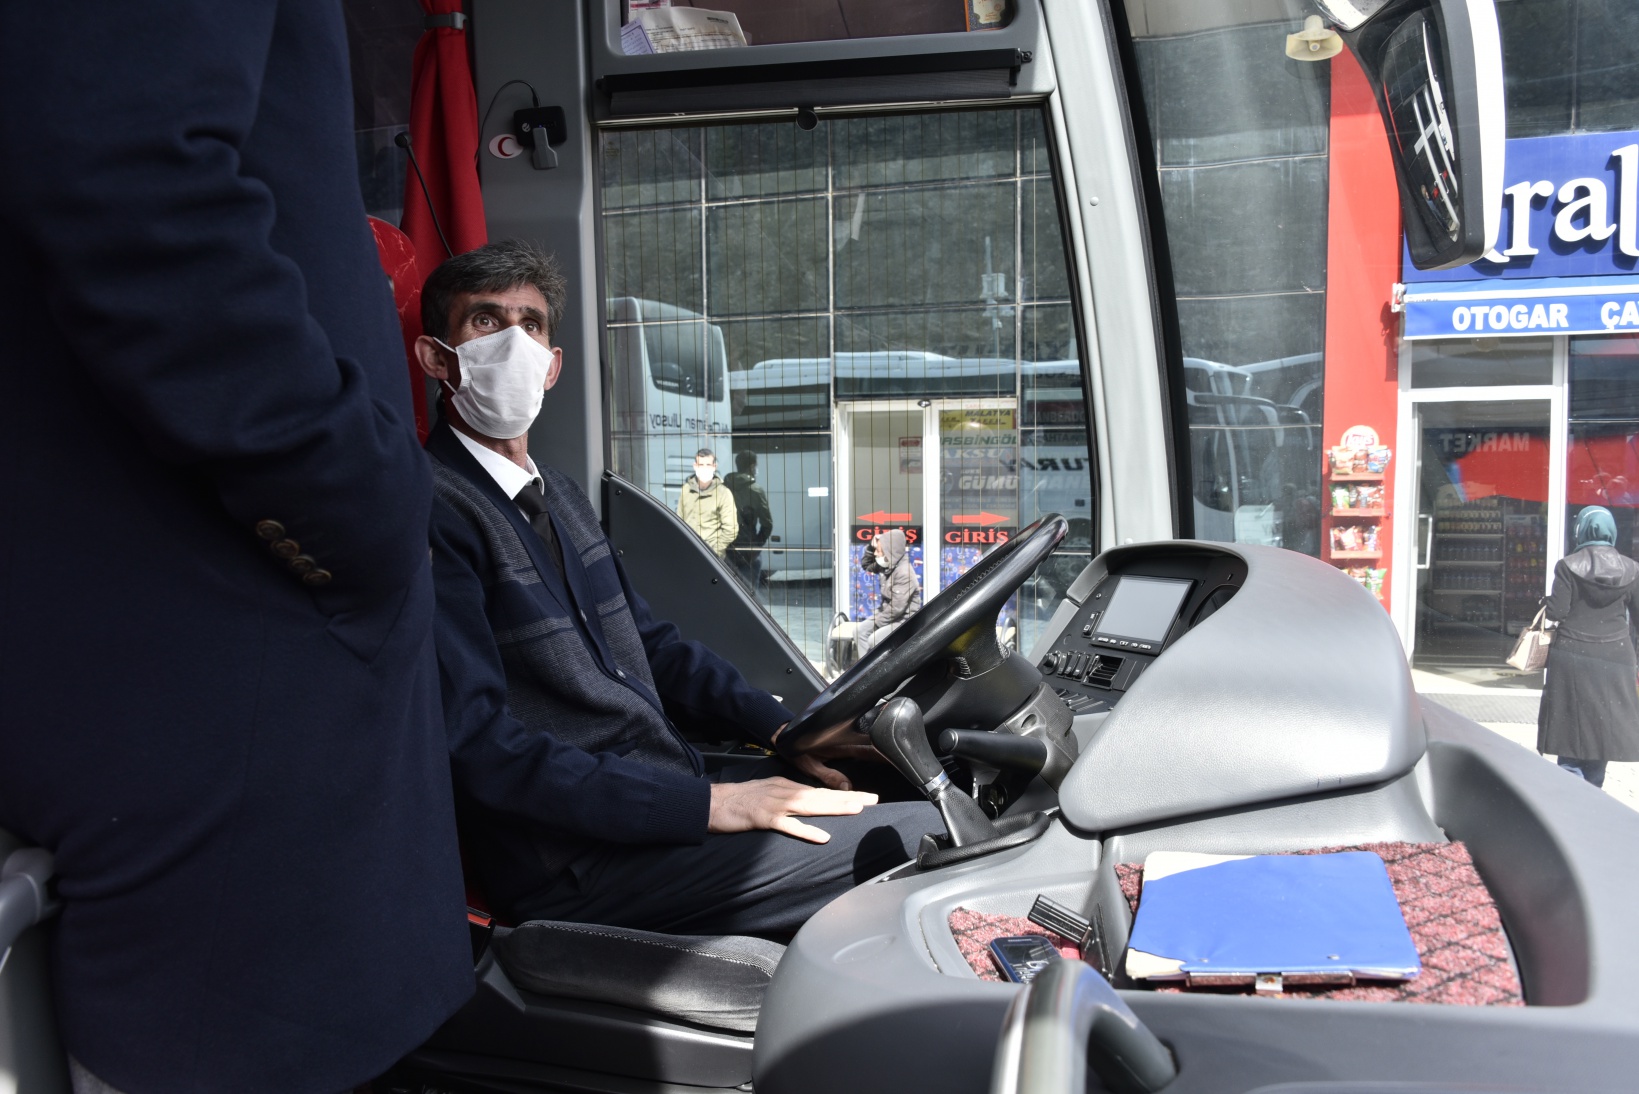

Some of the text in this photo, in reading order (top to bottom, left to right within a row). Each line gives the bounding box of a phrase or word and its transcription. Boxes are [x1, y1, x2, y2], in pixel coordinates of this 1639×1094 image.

[1482, 143, 1639, 264] ral
[1451, 300, 1639, 332] OTOGAR ÇA
[965, 409, 1012, 417] MALATYA
[856, 525, 918, 544] GİŞ
